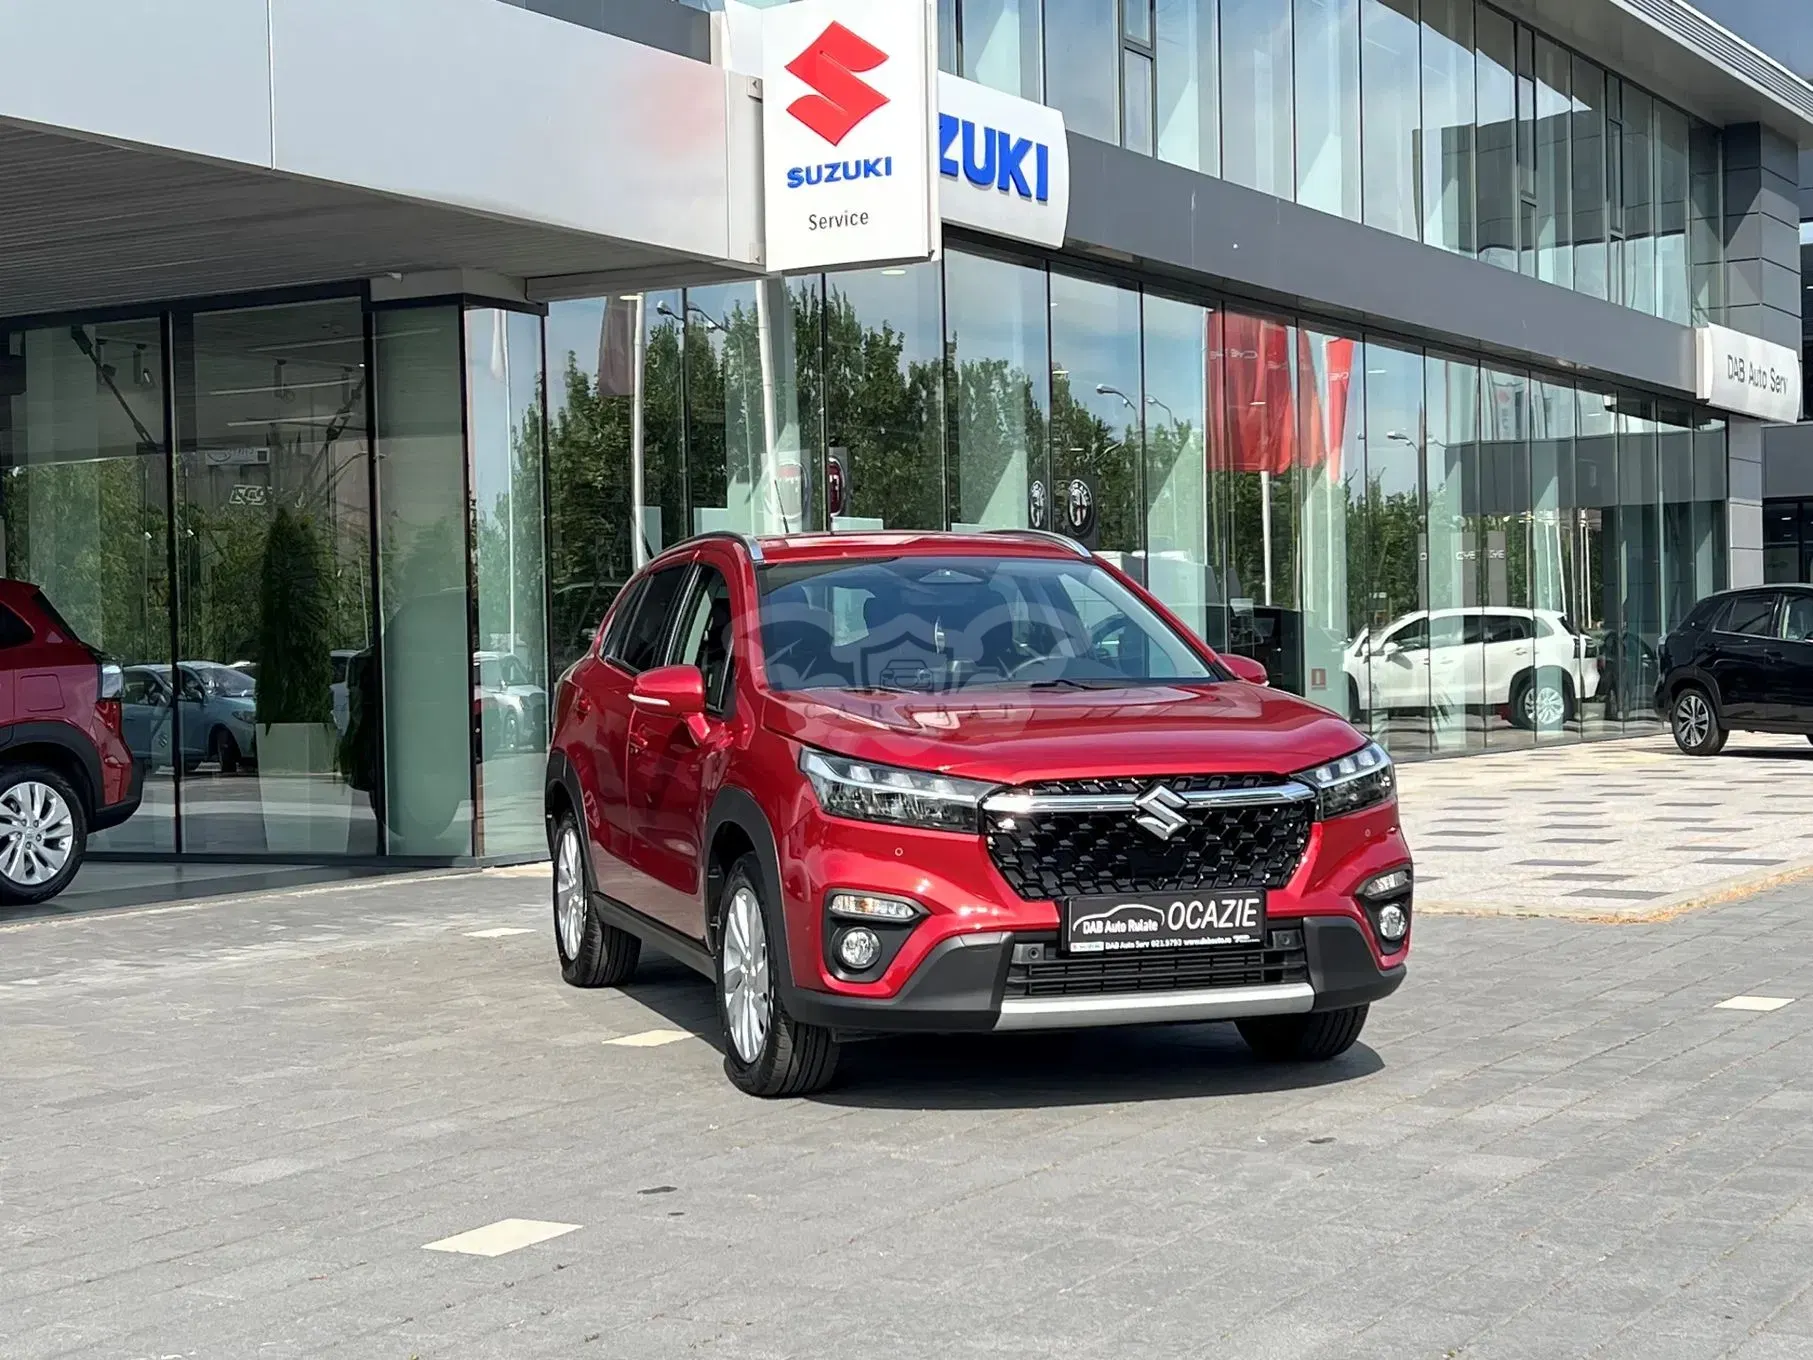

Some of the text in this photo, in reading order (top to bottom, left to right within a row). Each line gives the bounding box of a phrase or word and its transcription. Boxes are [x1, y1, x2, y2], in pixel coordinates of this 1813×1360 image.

[787, 156, 893, 189] SUZUKI
[808, 210, 869, 230] Service
[1727, 354, 1788, 395] DAB Auto Serv
[1082, 920, 1104, 934] DAB
[1104, 919, 1127, 933] Auto
[1167, 898, 1260, 931] OCAZIE
[1105, 941, 1119, 949] DAB
[1120, 941, 1135, 949] Auto
[1135, 940, 1149, 948] Serv
